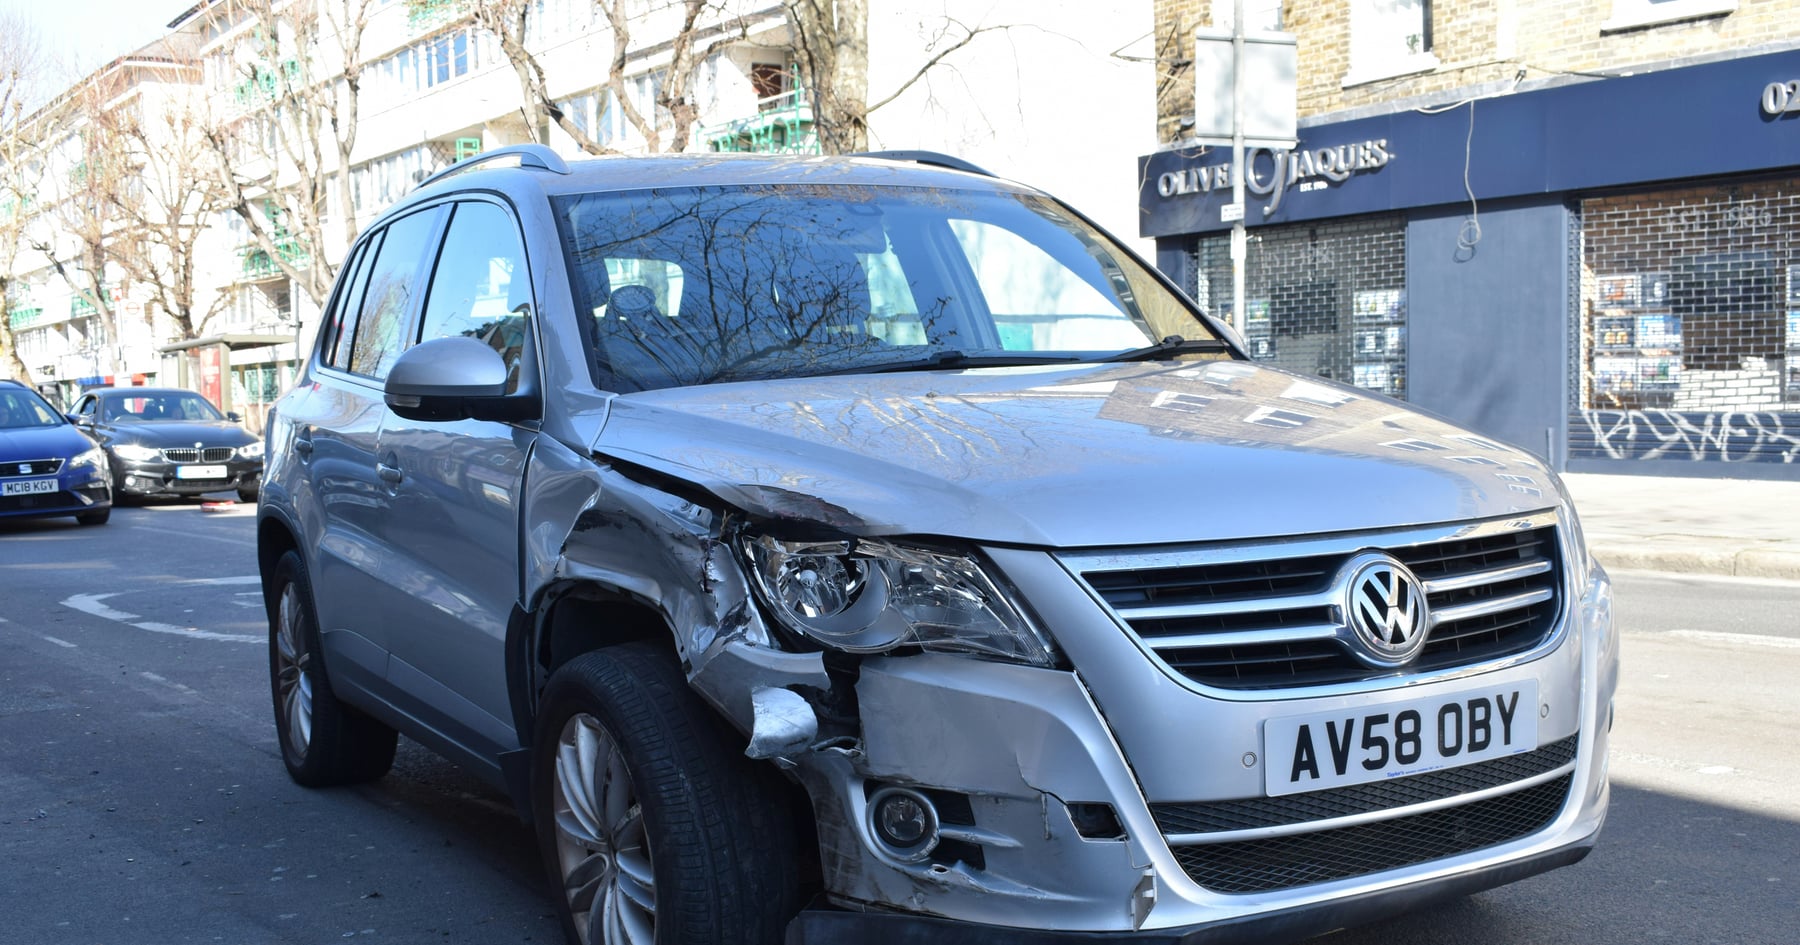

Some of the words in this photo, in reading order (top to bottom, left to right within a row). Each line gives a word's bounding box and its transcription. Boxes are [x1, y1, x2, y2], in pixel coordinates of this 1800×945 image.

[1286, 139, 1389, 186] JAQUES
[6, 482, 31, 493] MC18
[33, 480, 54, 491] KGV
[1290, 709, 1422, 782] AV58
[1437, 691, 1519, 758] OBY
